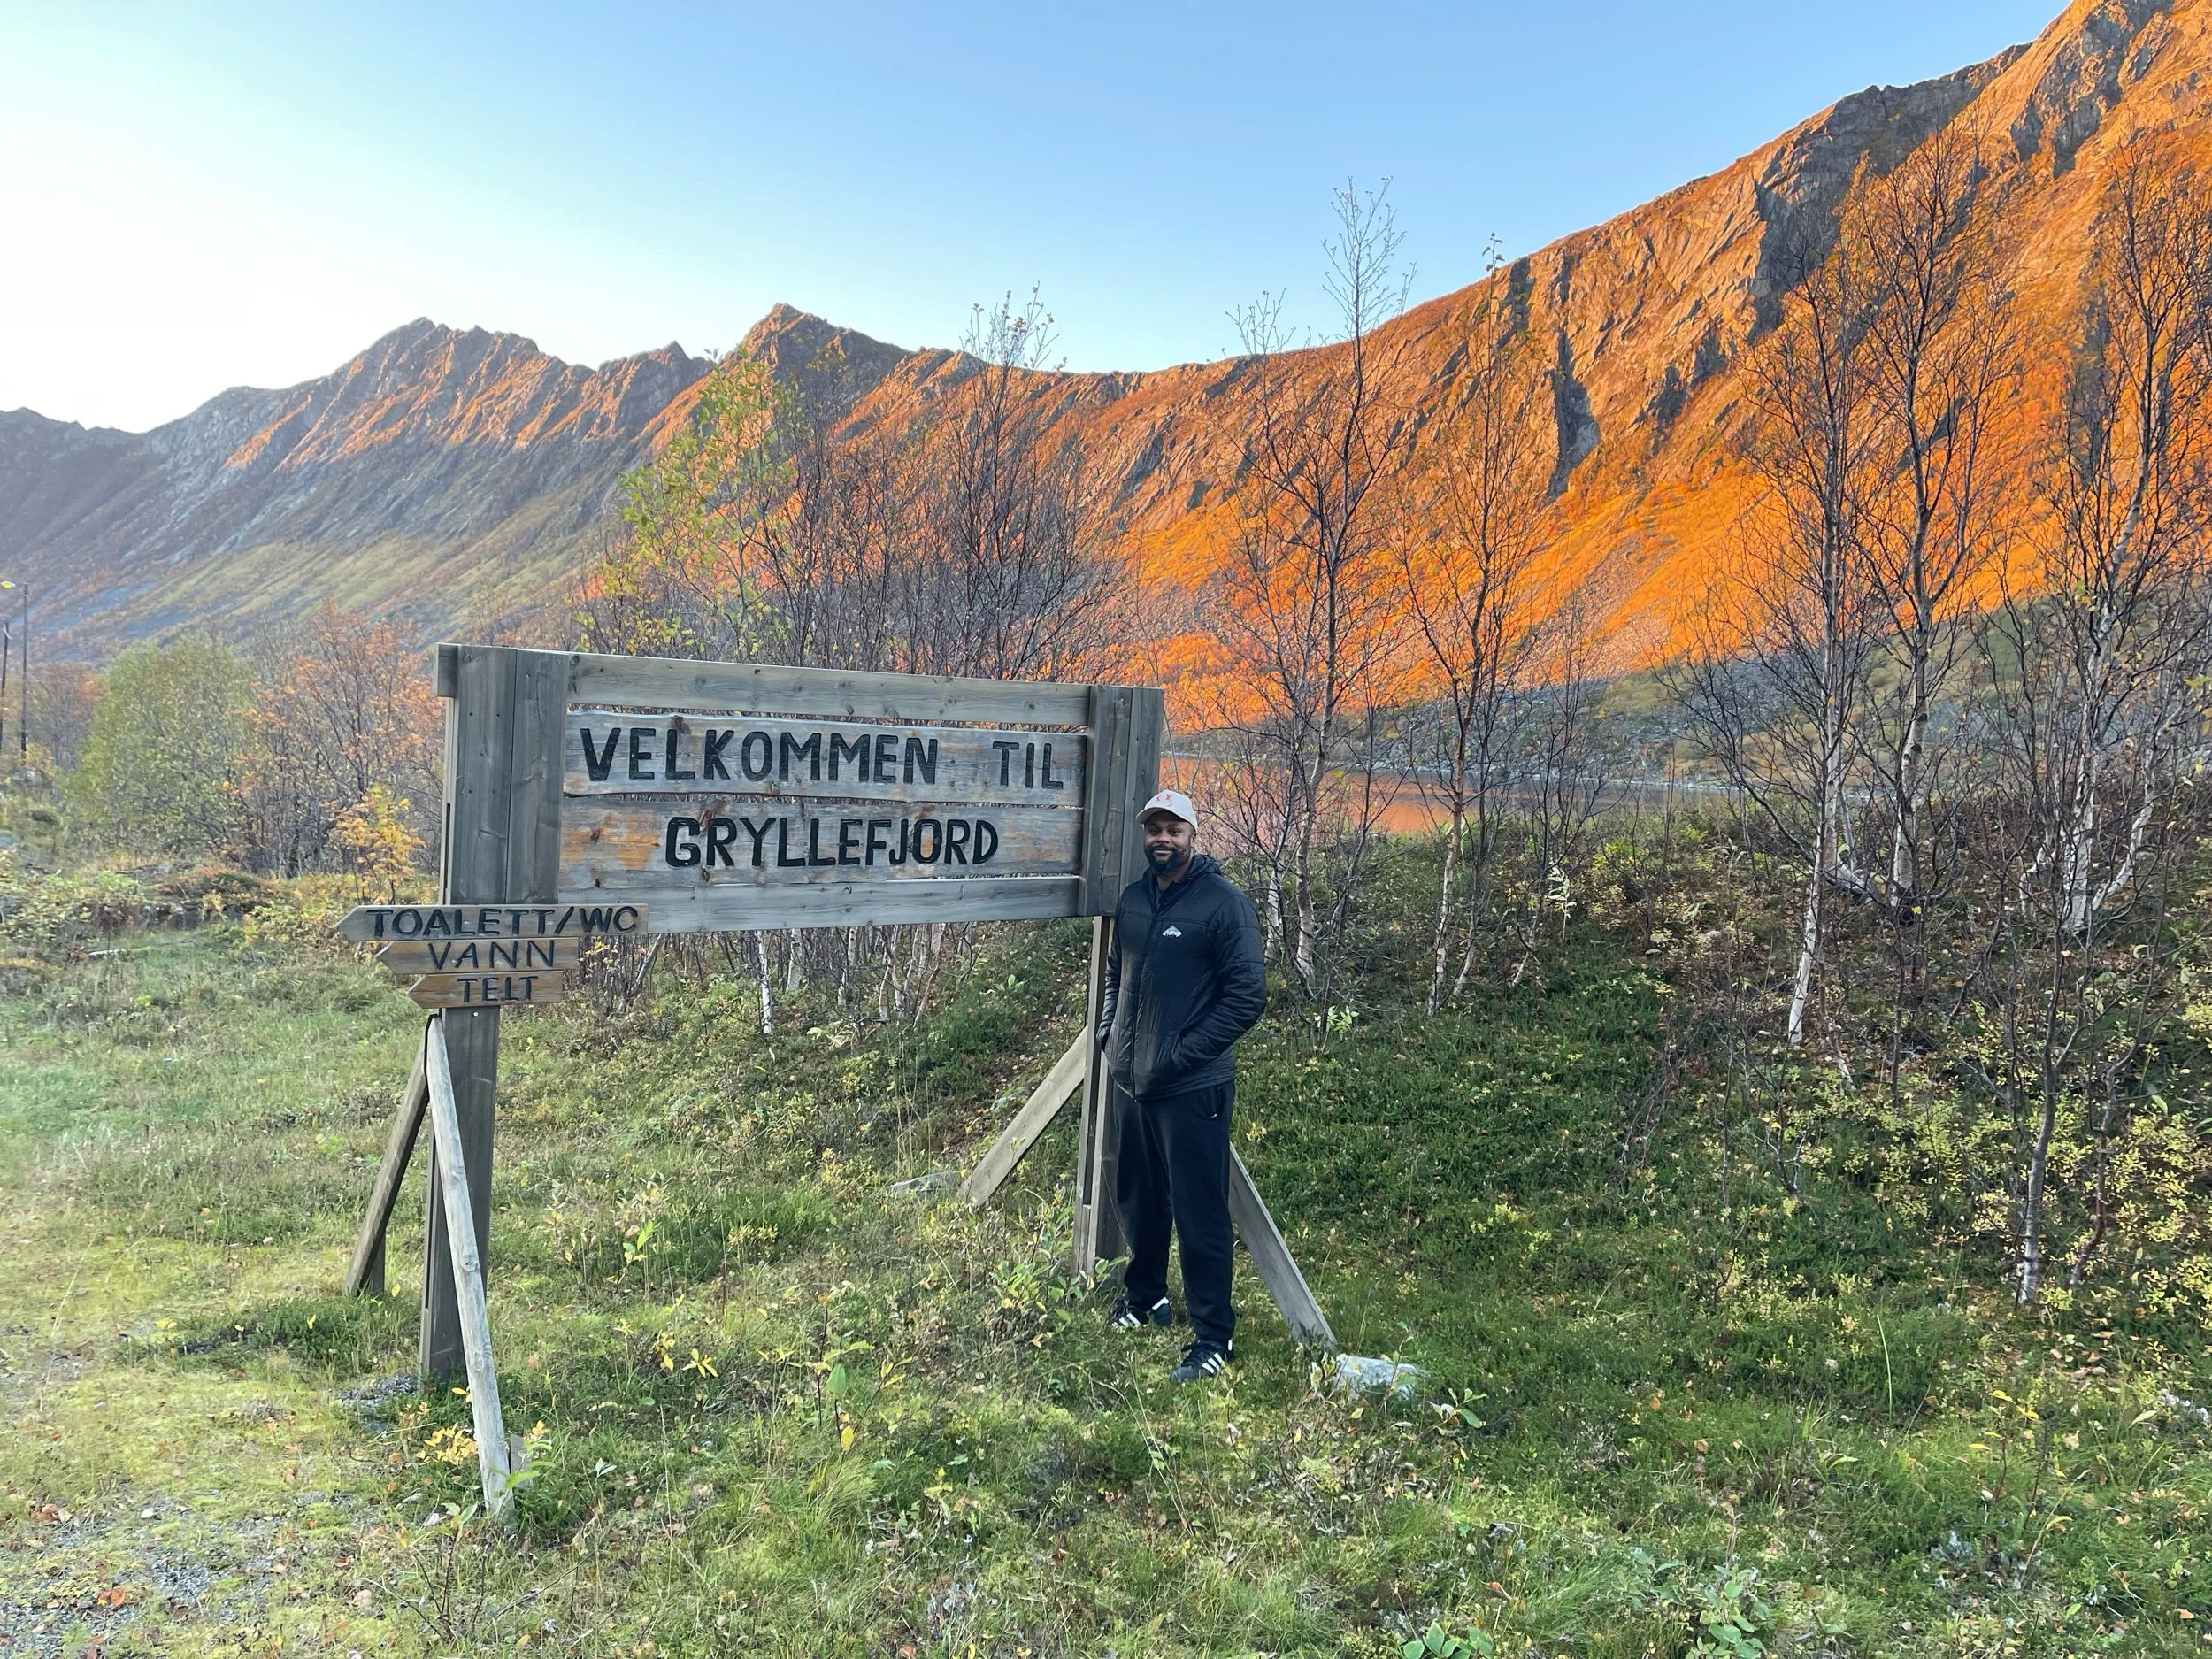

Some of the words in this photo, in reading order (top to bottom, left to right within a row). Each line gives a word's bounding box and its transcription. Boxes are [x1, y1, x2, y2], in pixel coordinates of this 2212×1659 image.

[580, 726, 939, 786] VELKOMMEN
[991, 740, 1064, 790] TIL
[664, 816, 999, 868] GRYLLEFJORD
[365, 905, 640, 939] TOALETT/WC
[427, 939, 556, 971] VANN
[457, 975, 540, 1004] TELT
